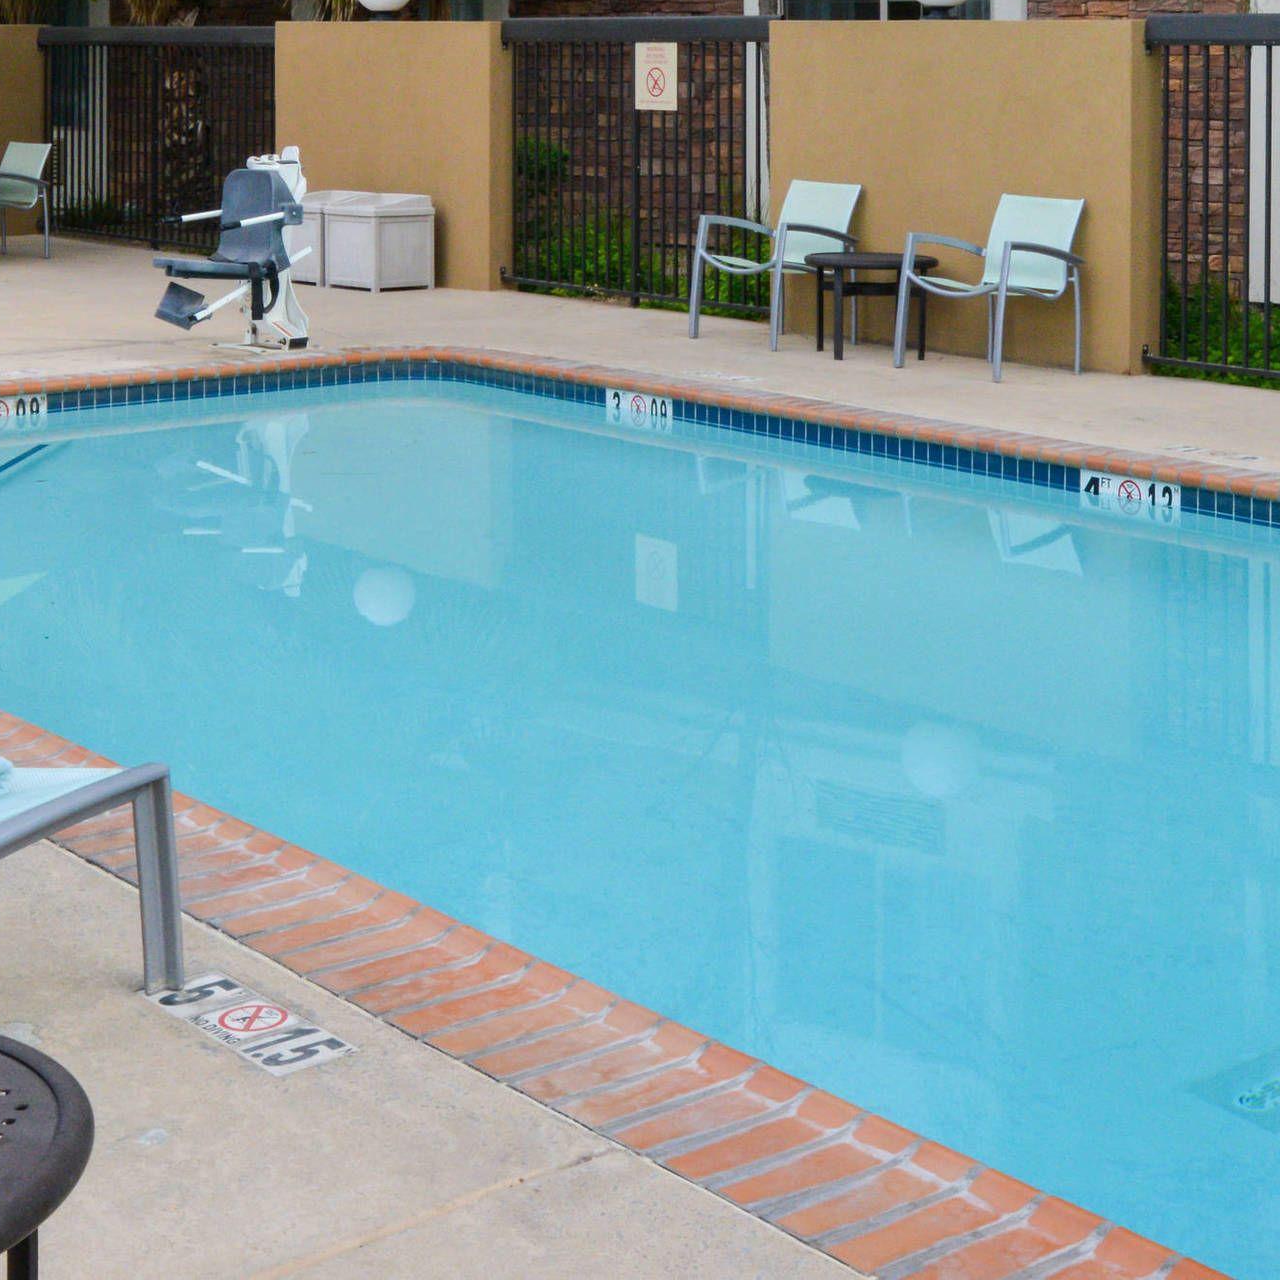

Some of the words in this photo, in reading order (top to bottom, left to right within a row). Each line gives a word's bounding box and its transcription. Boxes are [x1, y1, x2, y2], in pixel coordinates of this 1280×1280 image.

[1084, 476, 1100, 495] 4
[1101, 478, 1111, 487] FT
[158, 978, 240, 1006] 5
[188, 1015, 208, 1026] NO
[202, 1023, 241, 1047] DIVING
